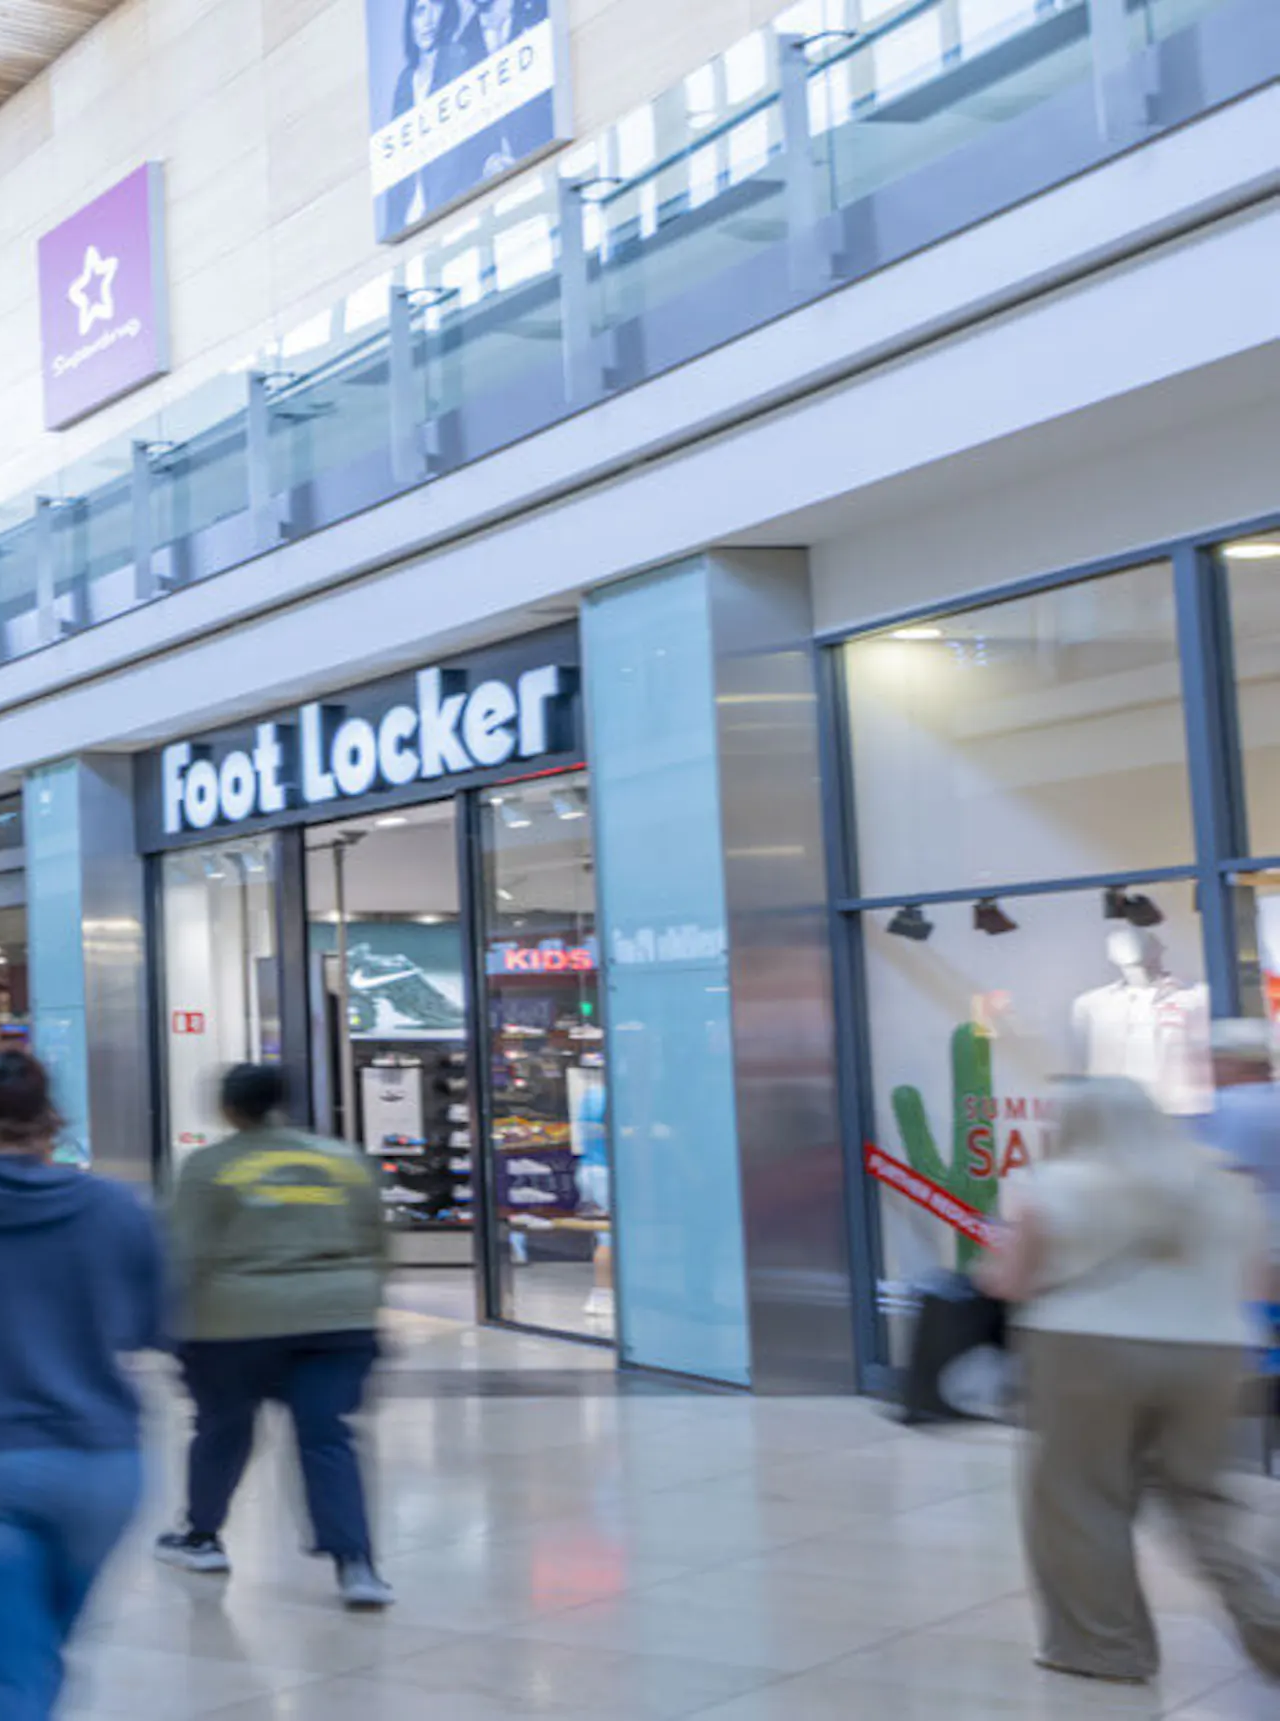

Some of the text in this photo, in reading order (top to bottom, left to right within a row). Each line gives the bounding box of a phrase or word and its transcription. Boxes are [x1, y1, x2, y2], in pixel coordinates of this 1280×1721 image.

[382, 45, 534, 159] SELECTED
[162, 664, 559, 834] Foot Locker
[504, 948, 593, 971] KIDS
[964, 1096, 1057, 1121] SUMM
[967, 1126, 1052, 1178] SA
